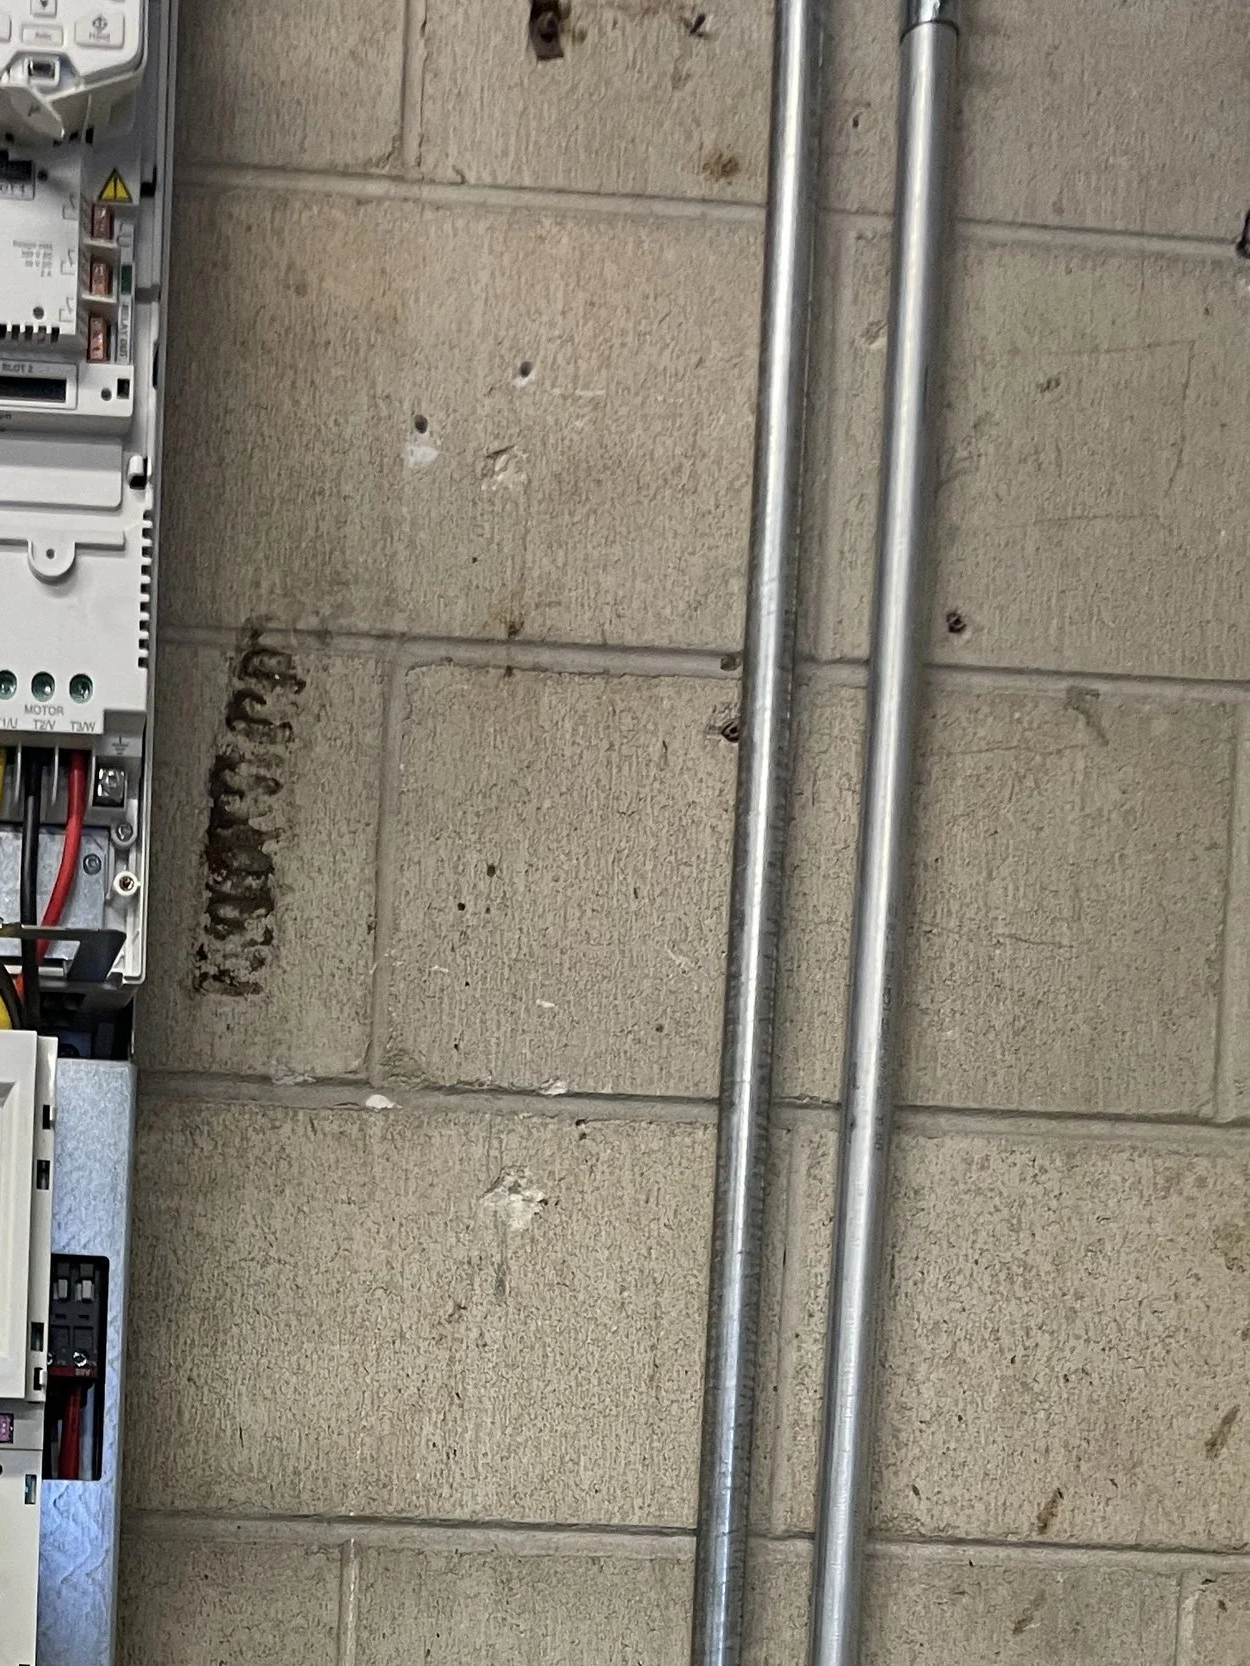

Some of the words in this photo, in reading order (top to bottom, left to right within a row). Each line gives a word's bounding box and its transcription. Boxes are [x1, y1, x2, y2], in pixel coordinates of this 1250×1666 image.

[2, 363, 25, 373] SLOT
[27, 364, 34, 373] 2
[24, 704, 64, 716] MOTOR
[33, 719, 56, 730] T2/V
[70, 721, 96, 732] T3/W
